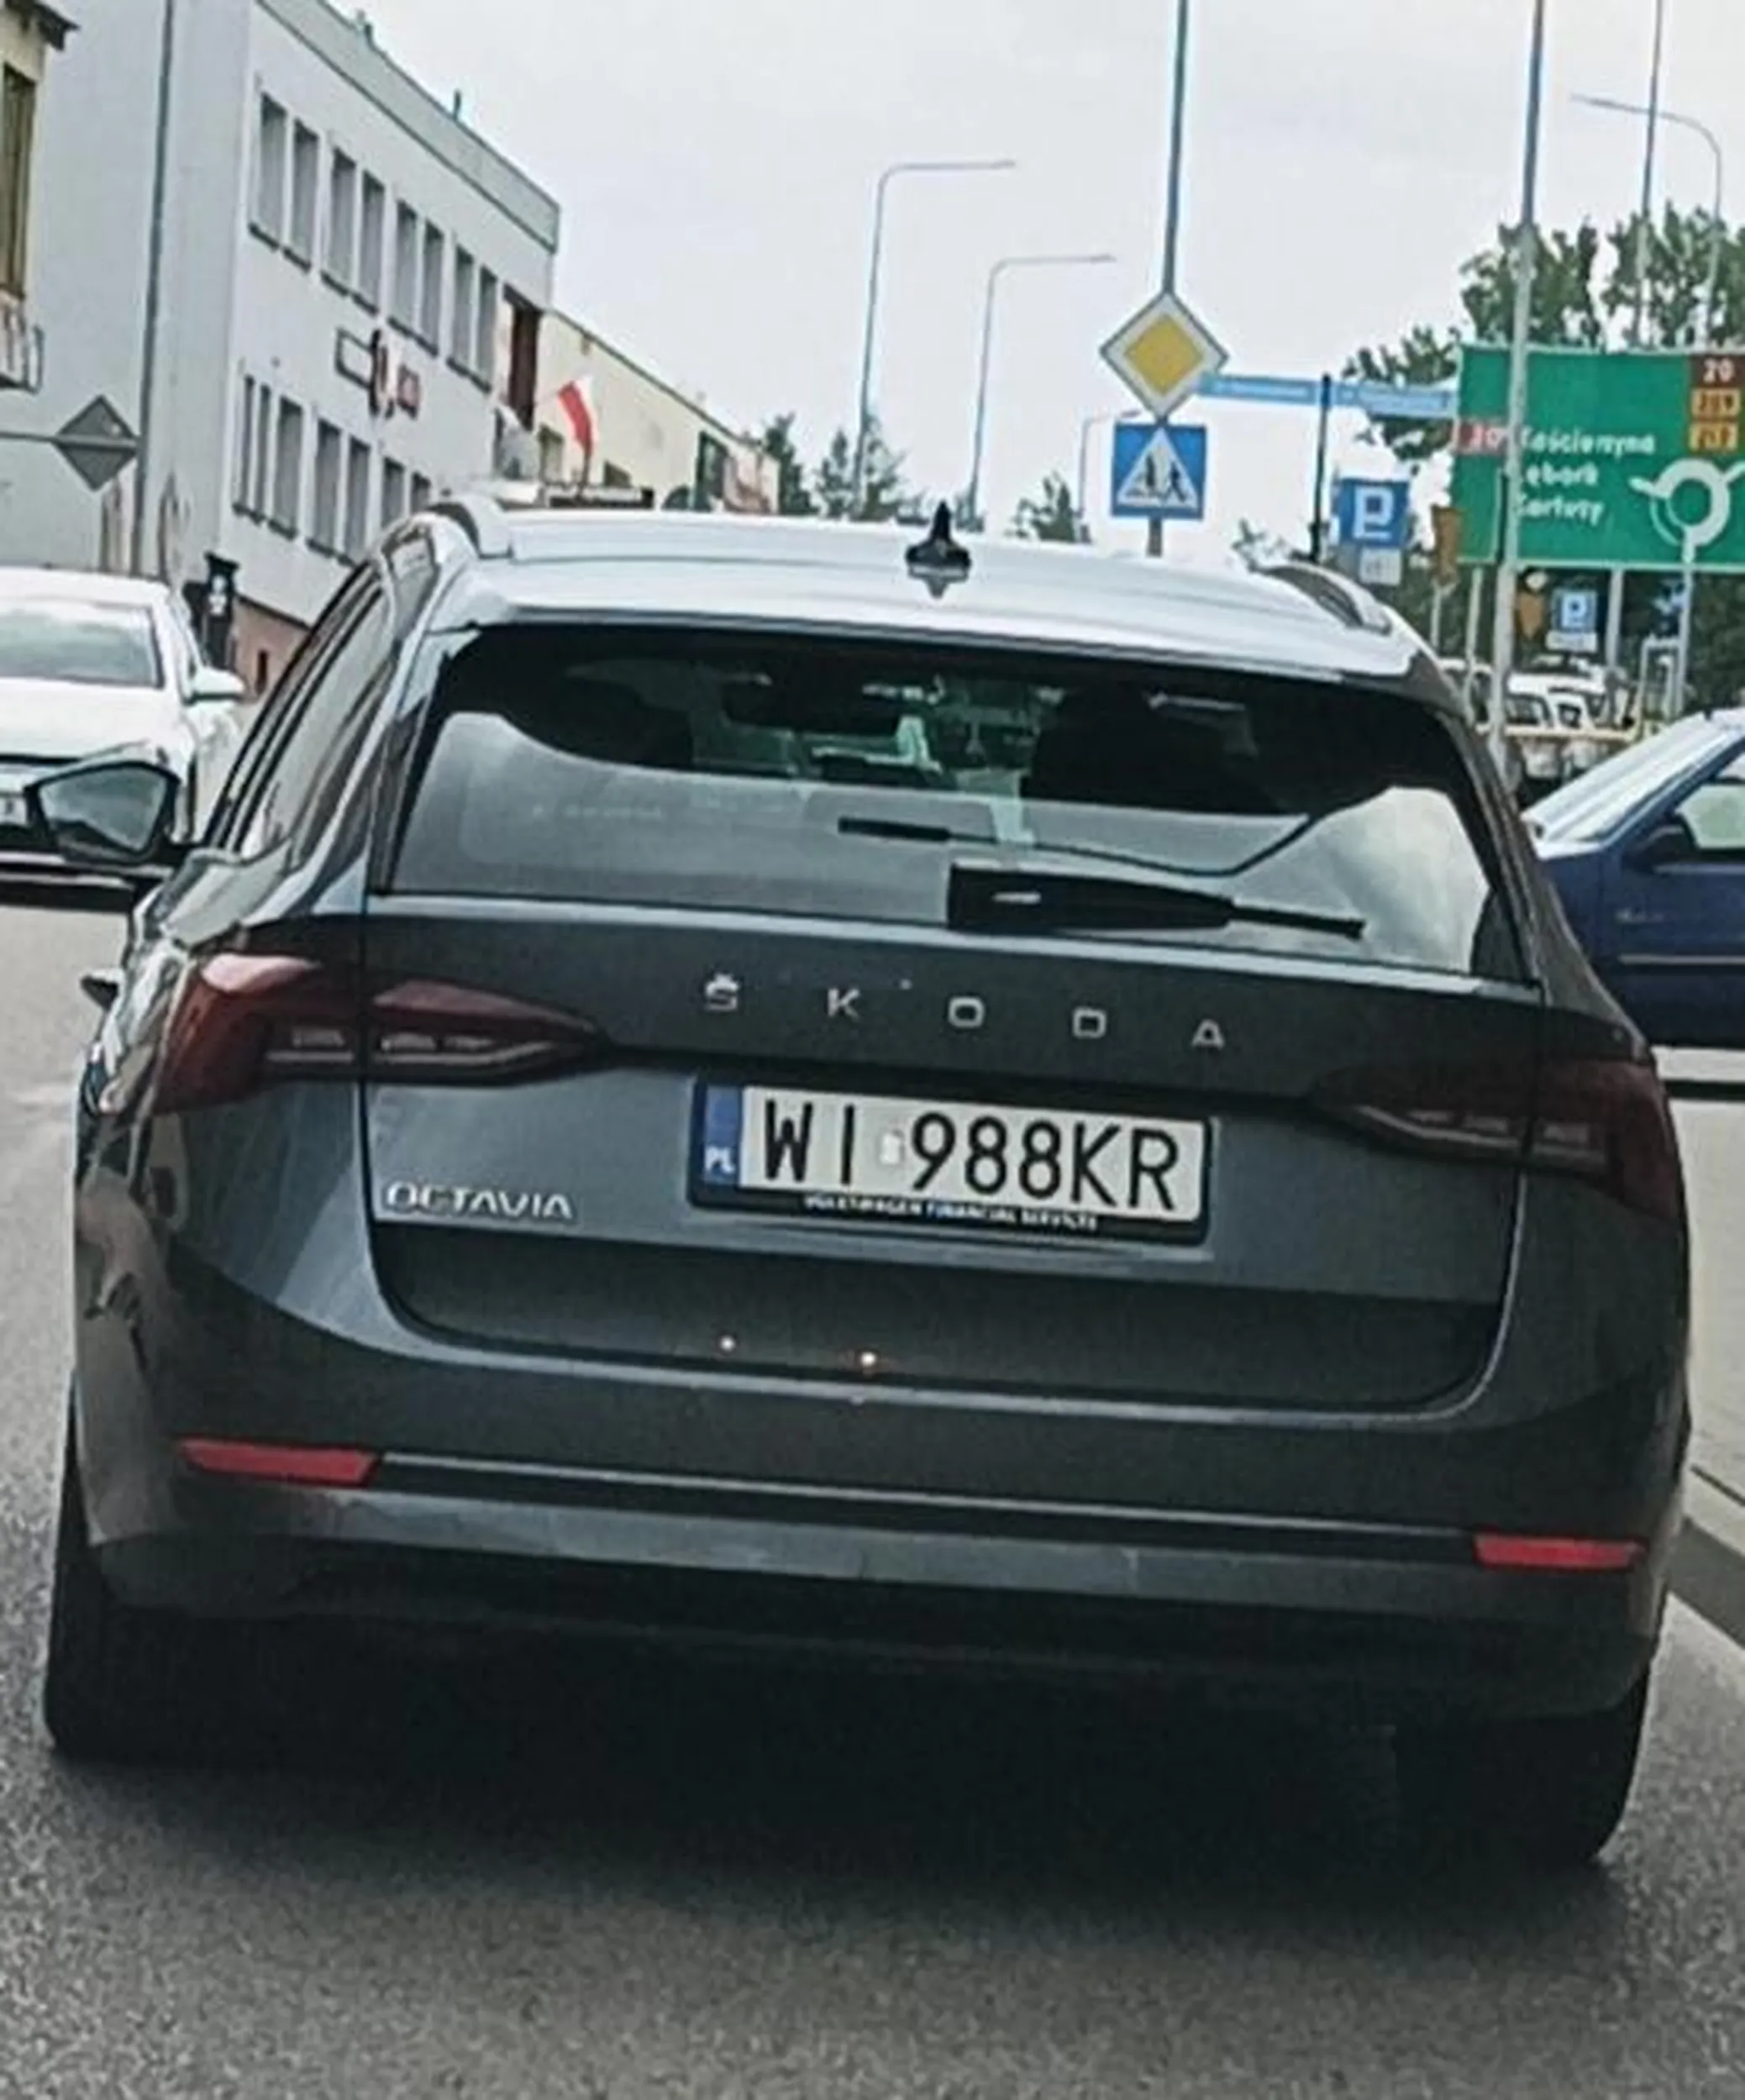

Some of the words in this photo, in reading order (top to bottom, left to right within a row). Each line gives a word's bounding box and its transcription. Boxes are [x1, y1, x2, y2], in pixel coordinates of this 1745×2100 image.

[764, 1098, 855, 1186] WI
[911, 1111, 1179, 1211] 988KR
[387, 1180, 573, 1220] OCTAVIA
